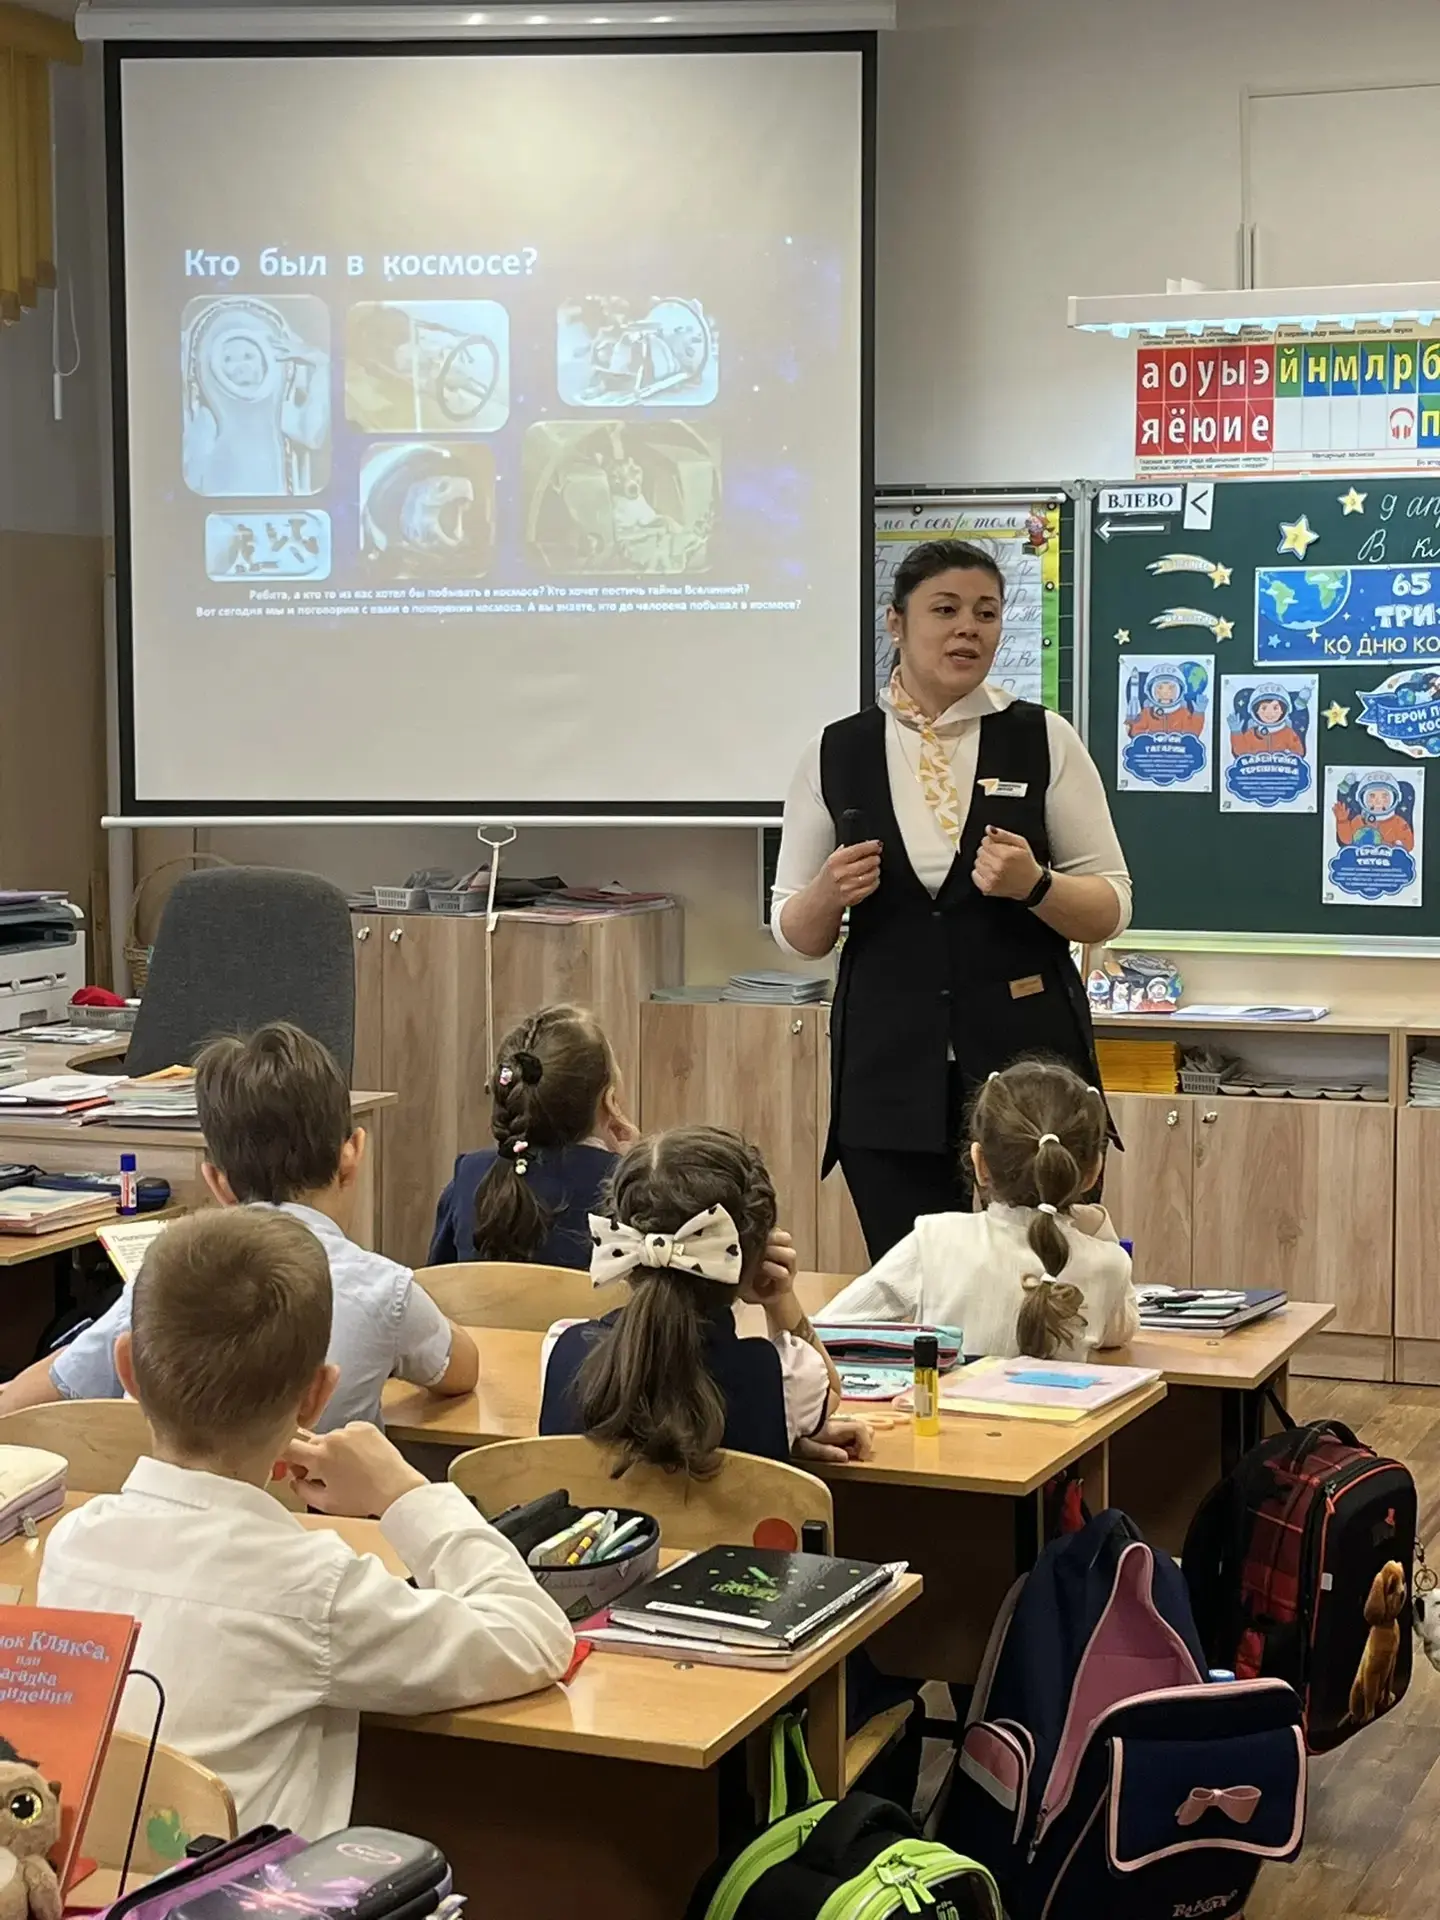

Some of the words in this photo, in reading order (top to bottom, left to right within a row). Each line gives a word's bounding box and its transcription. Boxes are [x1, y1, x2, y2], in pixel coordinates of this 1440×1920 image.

[185, 248, 240, 276] Кто
[259, 246, 327, 276] был
[347, 254, 364, 276] в
[383, 246, 538, 277] космосе?
[1108, 492, 1174, 509] ВЛЕВО
[1406, 495, 1440, 529] ап
[1357, 528, 1387, 563] В
[1392, 571, 1432, 596] 65
[1374, 602, 1440, 629] ТРИ
[1324, 638, 1352, 655] КО
[1356, 636, 1407, 657] ДНЮ
[1387, 708, 1427, 724] ГЕРОИ
